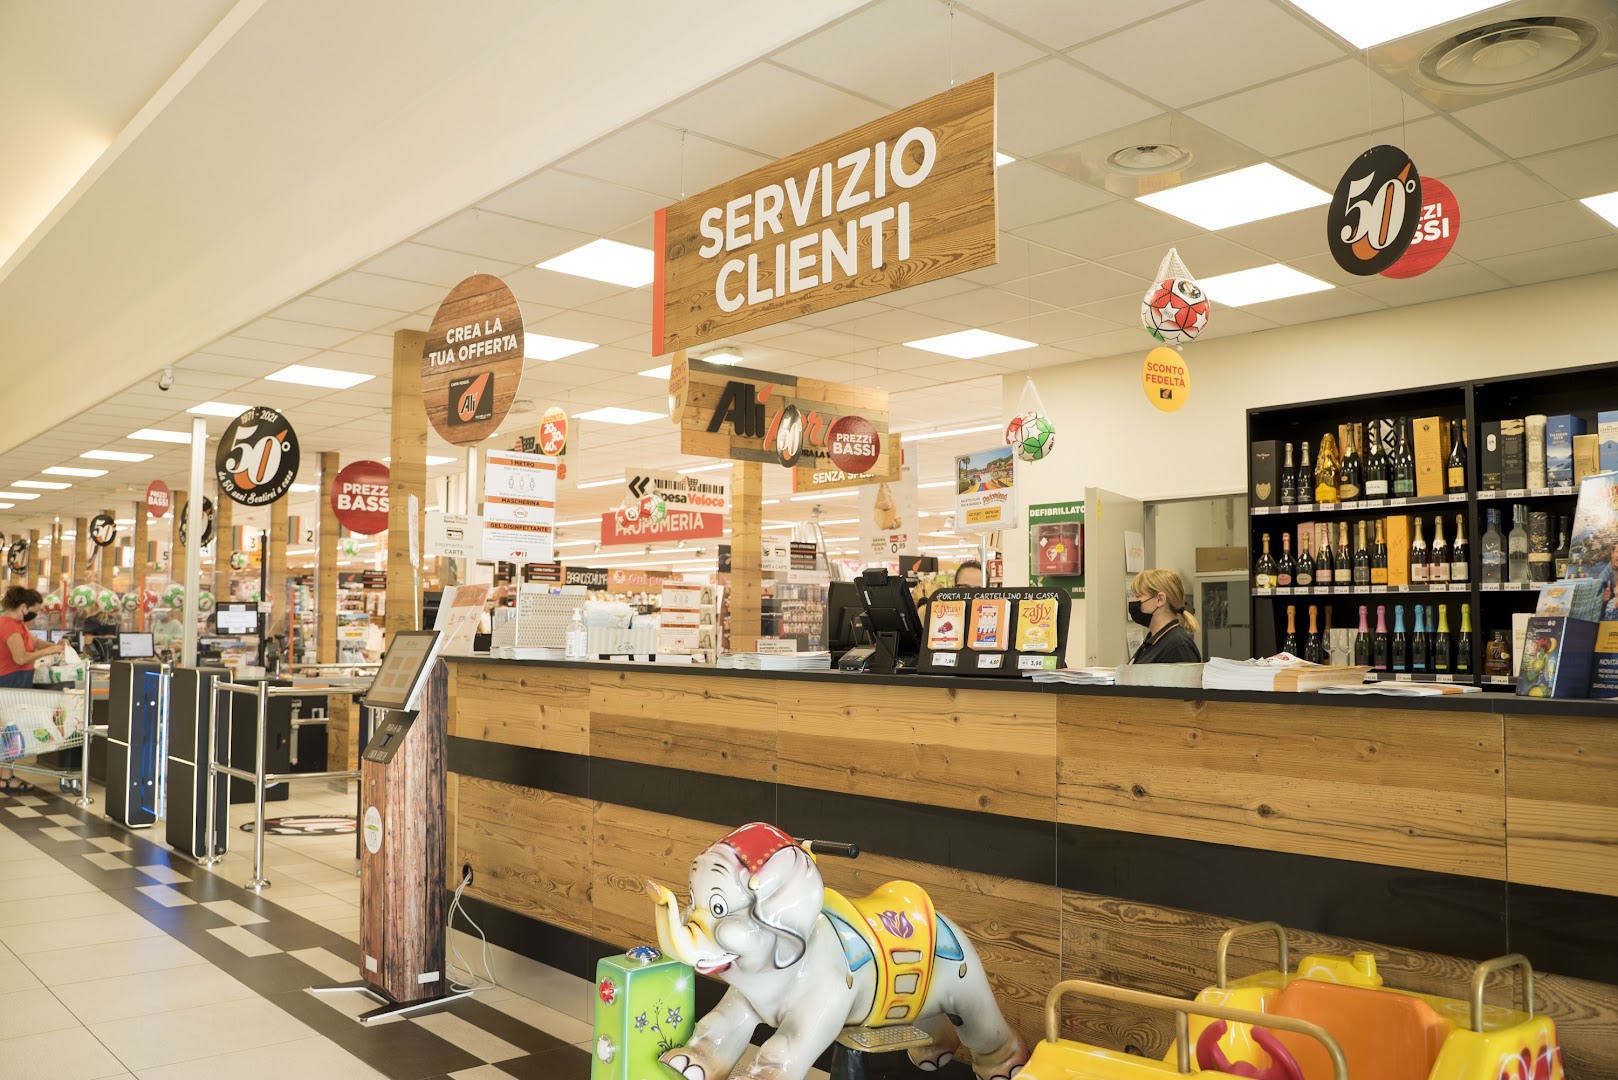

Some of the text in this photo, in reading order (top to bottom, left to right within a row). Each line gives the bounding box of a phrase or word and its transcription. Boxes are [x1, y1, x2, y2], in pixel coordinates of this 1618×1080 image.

[698, 126, 937, 259] SERVIZIO
[1411, 217, 1450, 246] SSI
[715, 201, 910, 313] CLIENTI
[446, 317, 503, 344] CREA LA
[428, 332, 518, 368] TUA OFFERTA
[1147, 362, 1184, 377] SCONTO
[1145, 372, 1186, 388] FEDELTÀ
[240, 410, 255, 424] 1971
[260, 409, 279, 423] 2021
[835, 433, 872, 445] PREZZI
[832, 441, 876, 457] BASSI
[812, 470, 845, 484] SENZA
[150, 490, 168, 498] PREZZI
[218, 471, 226, 481] da
[222, 479, 234, 492] 50
[231, 490, 248, 502] anni
[246, 488, 277, 504] Sentirsi
[281, 470, 294, 488] casa
[342, 482, 389, 496] PREZZ
[148, 496, 169, 507] BASSI
[337, 493, 390, 513] BASS
[501, 498, 540, 506] MASCHERINA
[687, 493, 724, 507] Veloce
[1029, 505, 1085, 517] DEFIBRILLATO
[503, 523, 548, 532] DISINFETTANTE
[306, 530, 313, 542] 2
[250, 538, 256, 549] 3
[163, 551, 169, 560] 5
[938, 592, 960, 600] PORTA
[963, 592, 972, 600] IL
[974, 592, 1021, 600] CARTELLINO
[1035, 592, 1059, 600] CASSA
[1021, 603, 1051, 624] zaffy
